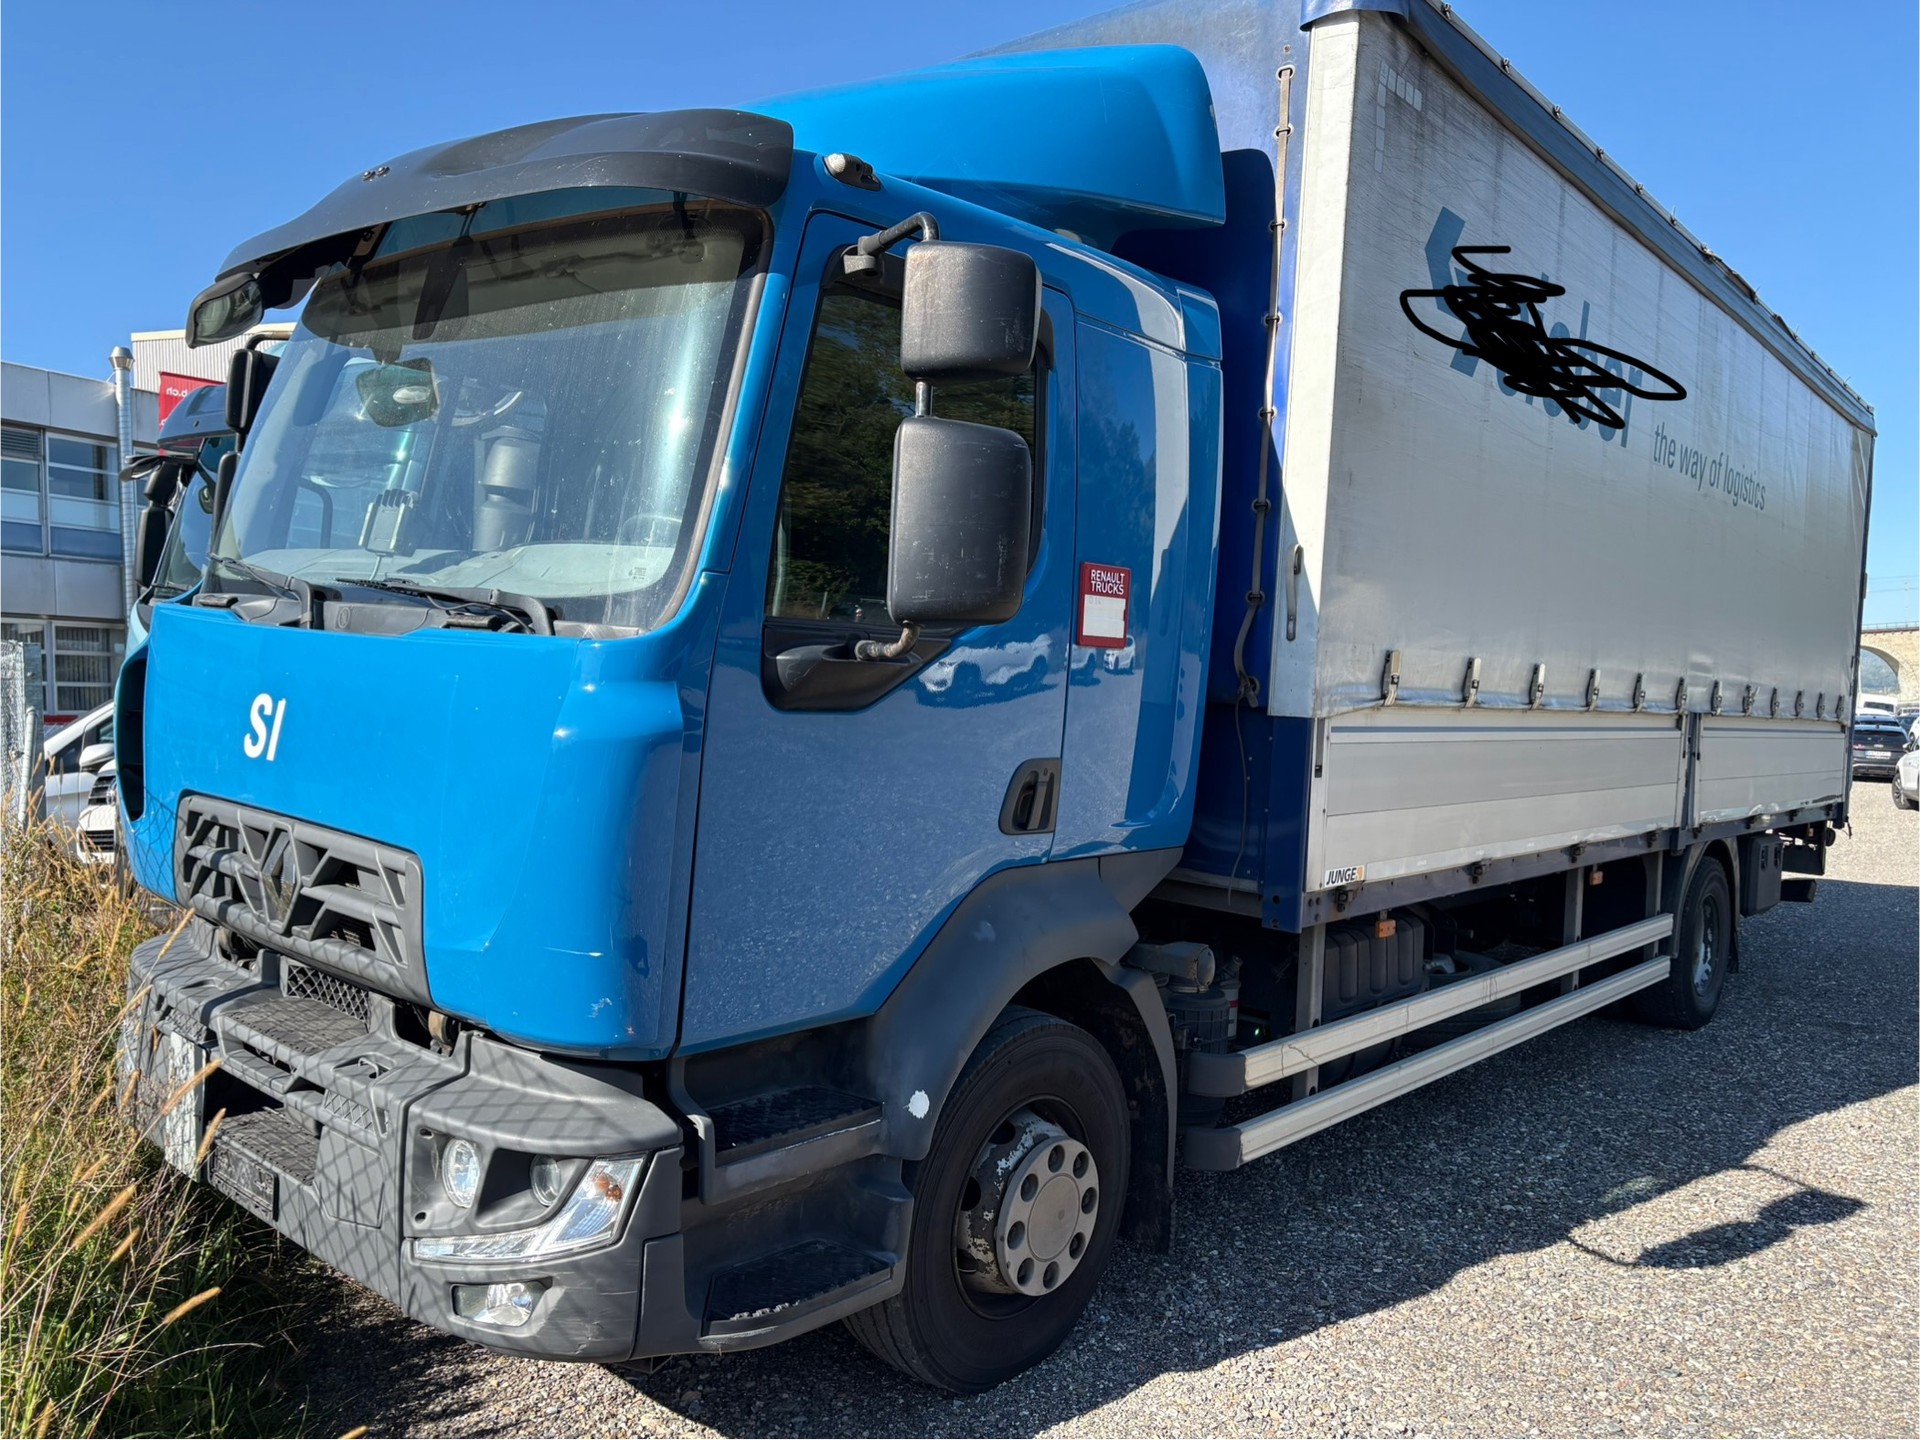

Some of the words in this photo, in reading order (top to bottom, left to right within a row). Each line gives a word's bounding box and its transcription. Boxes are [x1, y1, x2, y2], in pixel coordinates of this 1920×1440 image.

[1653, 421, 1677, 470] the
[1679, 443, 1708, 492] way
[1708, 451, 1725, 490] of
[1723, 454, 1767, 511] logistics
[1090, 569, 1125, 584] RENAULT
[1090, 581, 1124, 595] TRUCKS
[243, 692, 287, 762] SI
[1325, 867, 1357, 886] JUNGE
